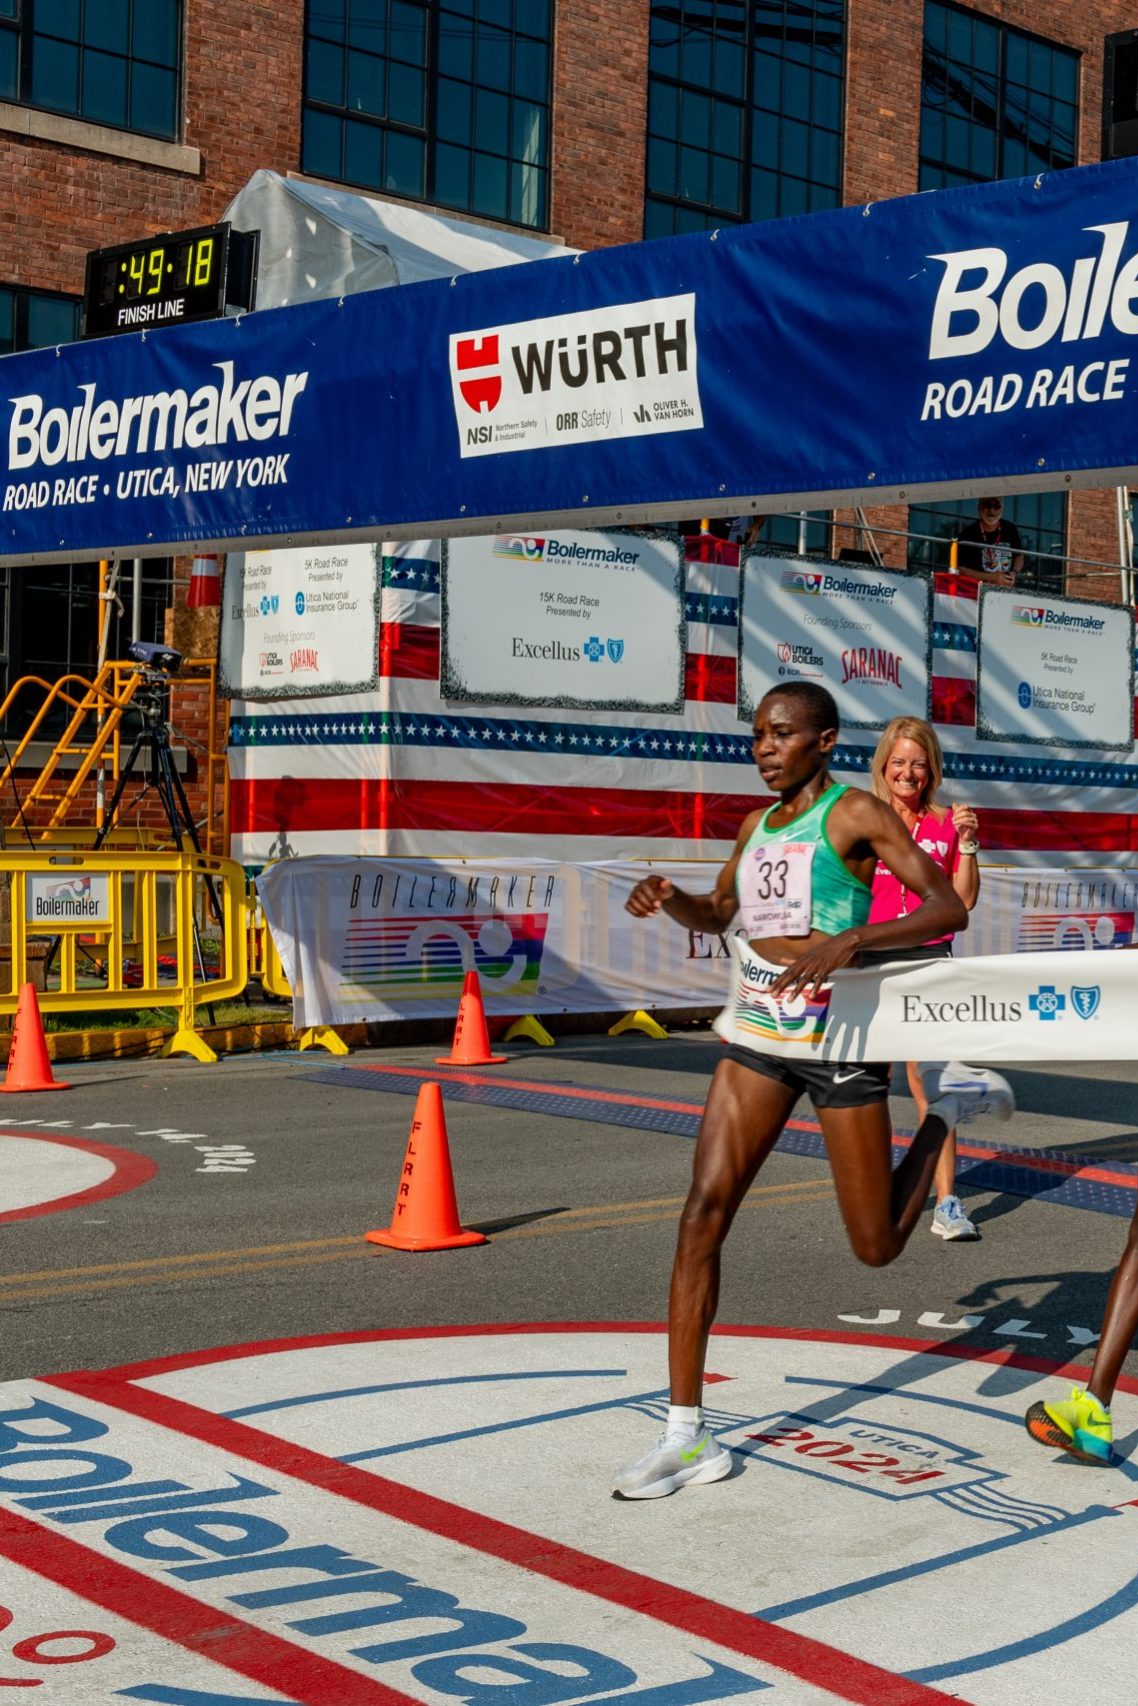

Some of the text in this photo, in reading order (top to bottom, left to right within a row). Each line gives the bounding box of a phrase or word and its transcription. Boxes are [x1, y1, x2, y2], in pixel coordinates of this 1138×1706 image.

[117, 299, 185, 326] FINISH LINE
[921, 378, 1026, 421] ROAD
[1027, 358, 1131, 406] RACE
[8, 360, 309, 470] Boilermaker
[653, 399, 689, 413] OLIVER H.
[654, 408, 694, 421] VAN HORN
[495, 420, 537, 433] Northern Safety
[556, 410, 611, 431] ORR Safety
[467, 426, 493, 445] NSI
[2, 453, 290, 512] ROAD RACE UTICA, NEW YORK
[314, 558, 331, 568] Road
[331, 557, 349, 567] Race
[547, 540, 640, 564] Boilermaker
[306, 591, 349, 602] Utica National
[823, 575, 897, 598] Boilermaker
[306, 600, 357, 613] Insurance Group
[539, 592, 600, 607] 15K Road Race
[546, 606, 592, 620] Presented by
[1045, 610, 1105, 630] Boilermaker
[512, 637, 580, 661] Excellus
[792, 646, 813, 655] UTICA
[792, 655, 824, 666] BOILERS
[841, 648, 903, 689] SARANAC
[1033, 686, 1085, 701] Utica National
[1033, 698, 1095, 715] Insurance Group
[757, 860, 788, 900] 33
[350, 874, 555, 909] BOILERMAKER
[1021, 882, 1138, 908] BOILERMAKER
[36, 896, 100, 916] Boilermaker
[901, 995, 1022, 1023] Excellus
[397, 1121, 422, 1216] FLRRT
[837, 1308, 1102, 1345] JULY
[745, 1427, 946, 1485] 2024
[848, 1429, 941, 1461] UTICA
